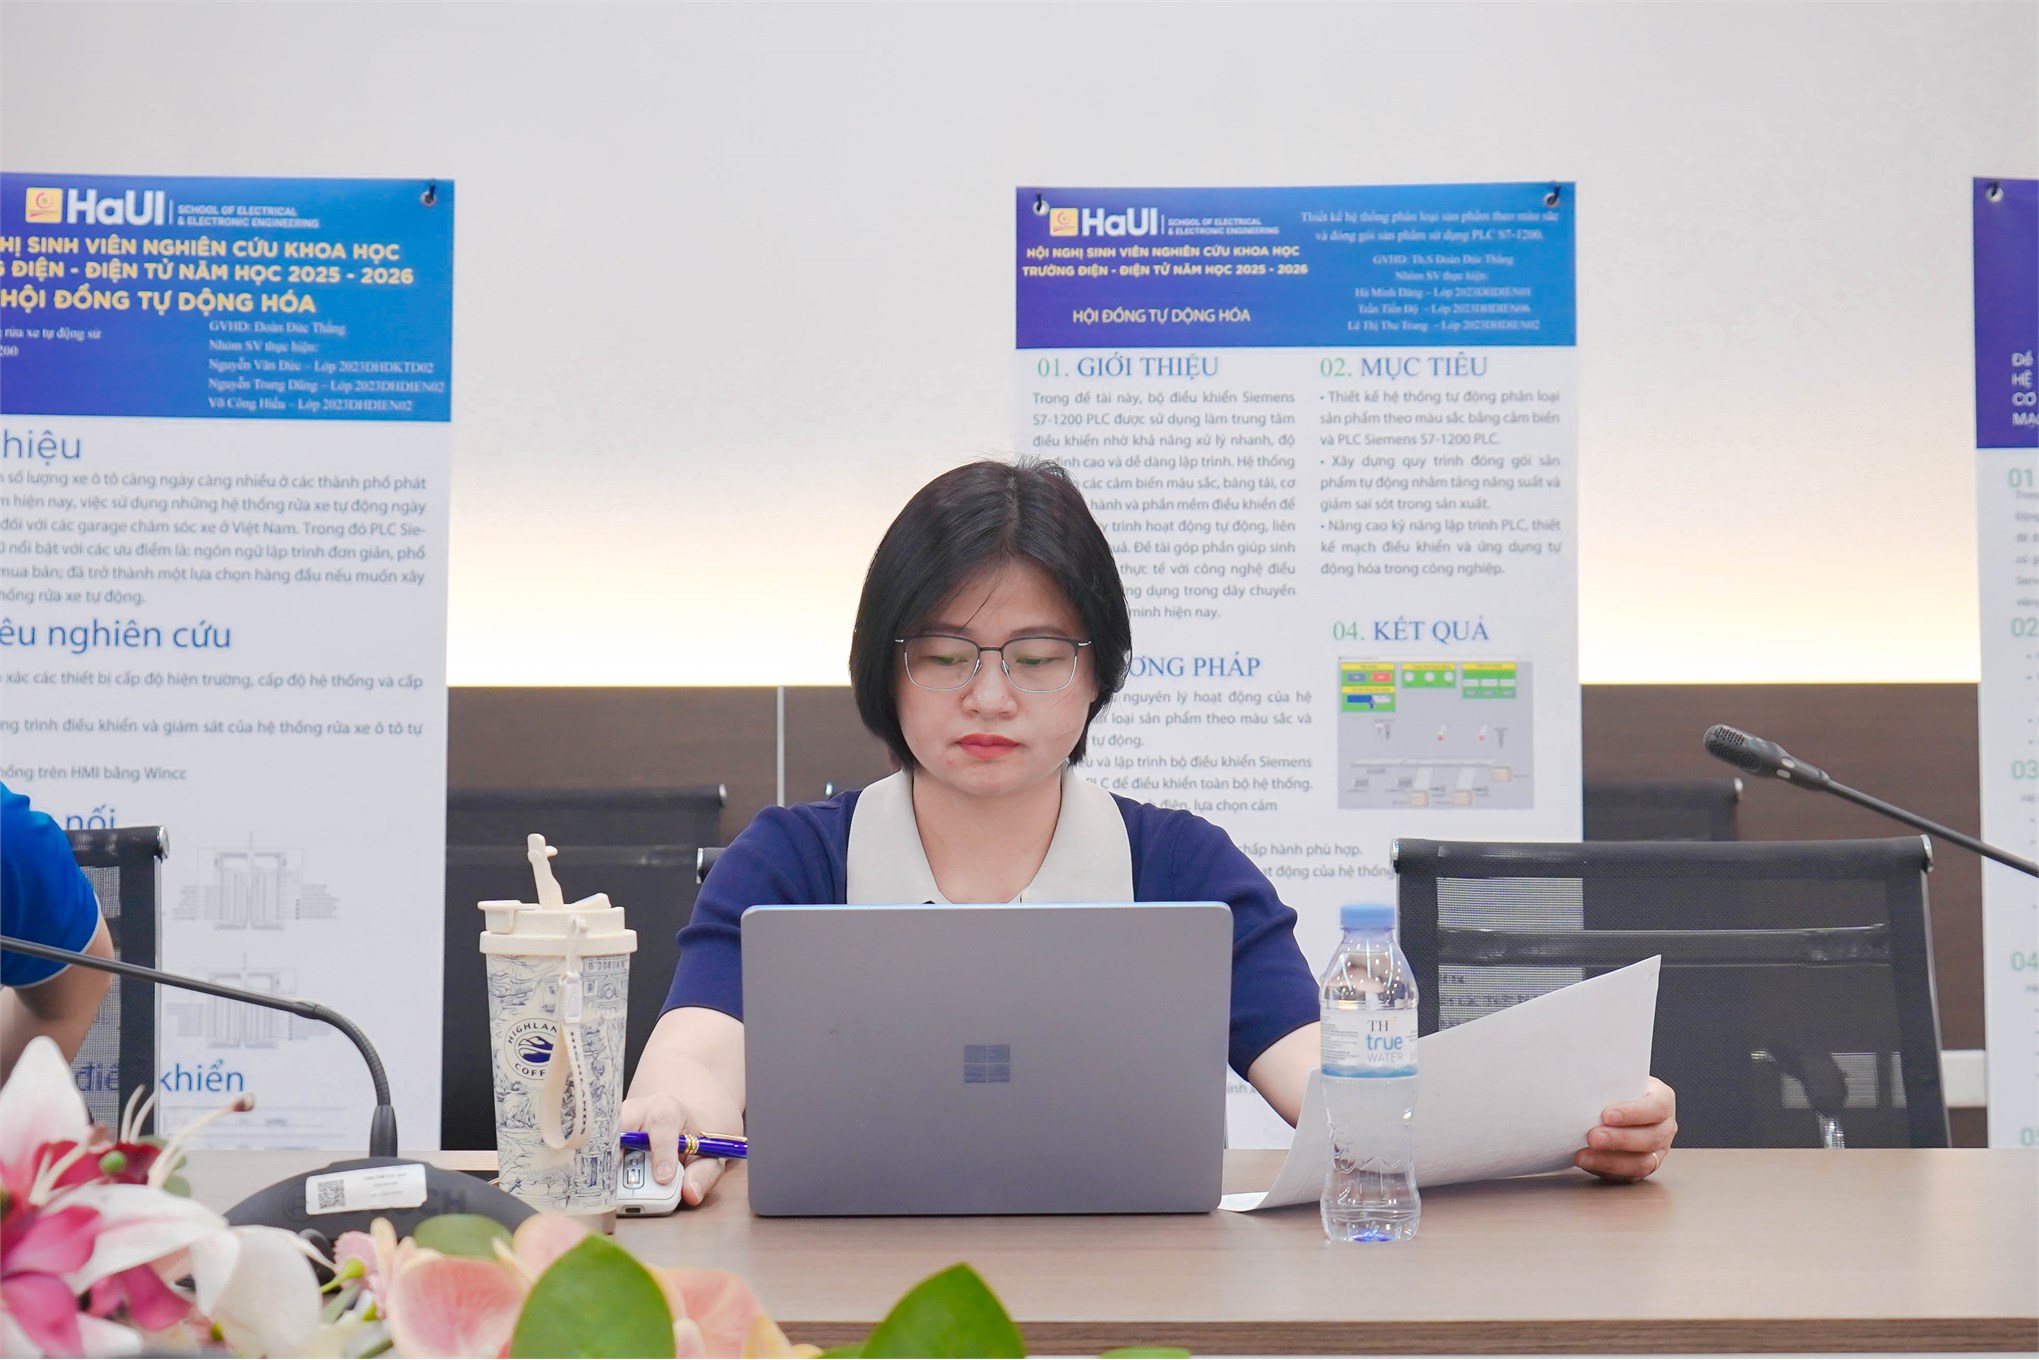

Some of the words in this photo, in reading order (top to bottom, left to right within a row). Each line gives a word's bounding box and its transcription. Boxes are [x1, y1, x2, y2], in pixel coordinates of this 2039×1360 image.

[67, 188, 165, 226] HaUI
[1082, 207, 1158, 236] HaUI
[0, 236, 21, 257] HỊ
[26, 236, 79, 258] SINH
[86, 233, 137, 259] VIÊN
[142, 235, 227, 260] NGHIÊN
[232, 236, 279, 258] CỨU
[284, 241, 347, 259] KHOA
[352, 243, 400, 264] HỌC
[1026, 245, 1050, 260] HỘI
[1052, 247, 1084, 260] NGHỊ
[1086, 247, 1116, 258] SINH
[1118, 244, 1149, 258] VIÊN
[1151, 244, 1200, 262] NGHIÊN
[1202, 244, 1230, 257] CỨU
[1232, 245, 1270, 256] KHOA
[1272, 245, 1300, 258] HỌC
[10, 257, 64, 281] ĐIỆN
[84, 259, 138, 284] ĐIỆN
[144, 258, 174, 280] TỬ
[178, 260, 228, 280] NĂM
[234, 264, 282, 286] HỌC
[287, 265, 341, 283] 2025
[360, 268, 414, 284] 2026
[1021, 263, 1075, 277] TRƯỜNG
[1077, 263, 1108, 278] ĐIỆN
[1118, 262, 1150, 278] ĐIỆN
[1152, 261, 1170, 276] TỬ
[1172, 262, 1202, 275] NĂM
[1204, 264, 1232, 276] HỌC
[1234, 264, 1266, 275] 2025
[1276, 263, 1308, 274] 2026
[0, 284, 46, 314] HỘI
[53, 283, 130, 310] ĐỒNG
[138, 289, 172, 316] TỰ
[260, 288, 316, 313] HÓA
[1072, 307, 1099, 325] HỘI
[1101, 306, 1146, 323] ĐỒNG
[1148, 307, 1168, 324] TỰ
[1218, 306, 1251, 322] HÓA
[1037, 358, 1068, 376] 01.
[1076, 351, 1131, 377] GIỚI
[1140, 354, 1218, 380] THIỆU
[1320, 357, 1352, 376] 02.
[1360, 354, 1419, 380] MỤC
[1428, 351, 1488, 376] TIÊU
[3, 429, 80, 466] hiệu
[1319, 433, 1335, 446] và
[1337, 432, 1361, 445] PLC
[1364, 432, 1418, 445] Siemens
[1419, 432, 1471, 445] S7-1200
[1473, 432, 1500, 445] PLC.
[0, 618, 36, 646] êu
[48, 619, 161, 654] nghiên
[172, 620, 230, 648] cứu
[1332, 621, 1364, 640] 04.
[1373, 615, 1424, 640] KẾT
[1431, 615, 1489, 644] QUẢ
[1128, 655, 1184, 676] ƠNG
[1193, 652, 1260, 676] PHÁP
[508, 1022, 557, 1044] HIGHLAN
[1367, 1020, 1389, 1032] TH
[1366, 1034, 1403, 1050] true
[514, 1063, 546, 1077] COFF
[1367, 1052, 1403, 1063] WATER
